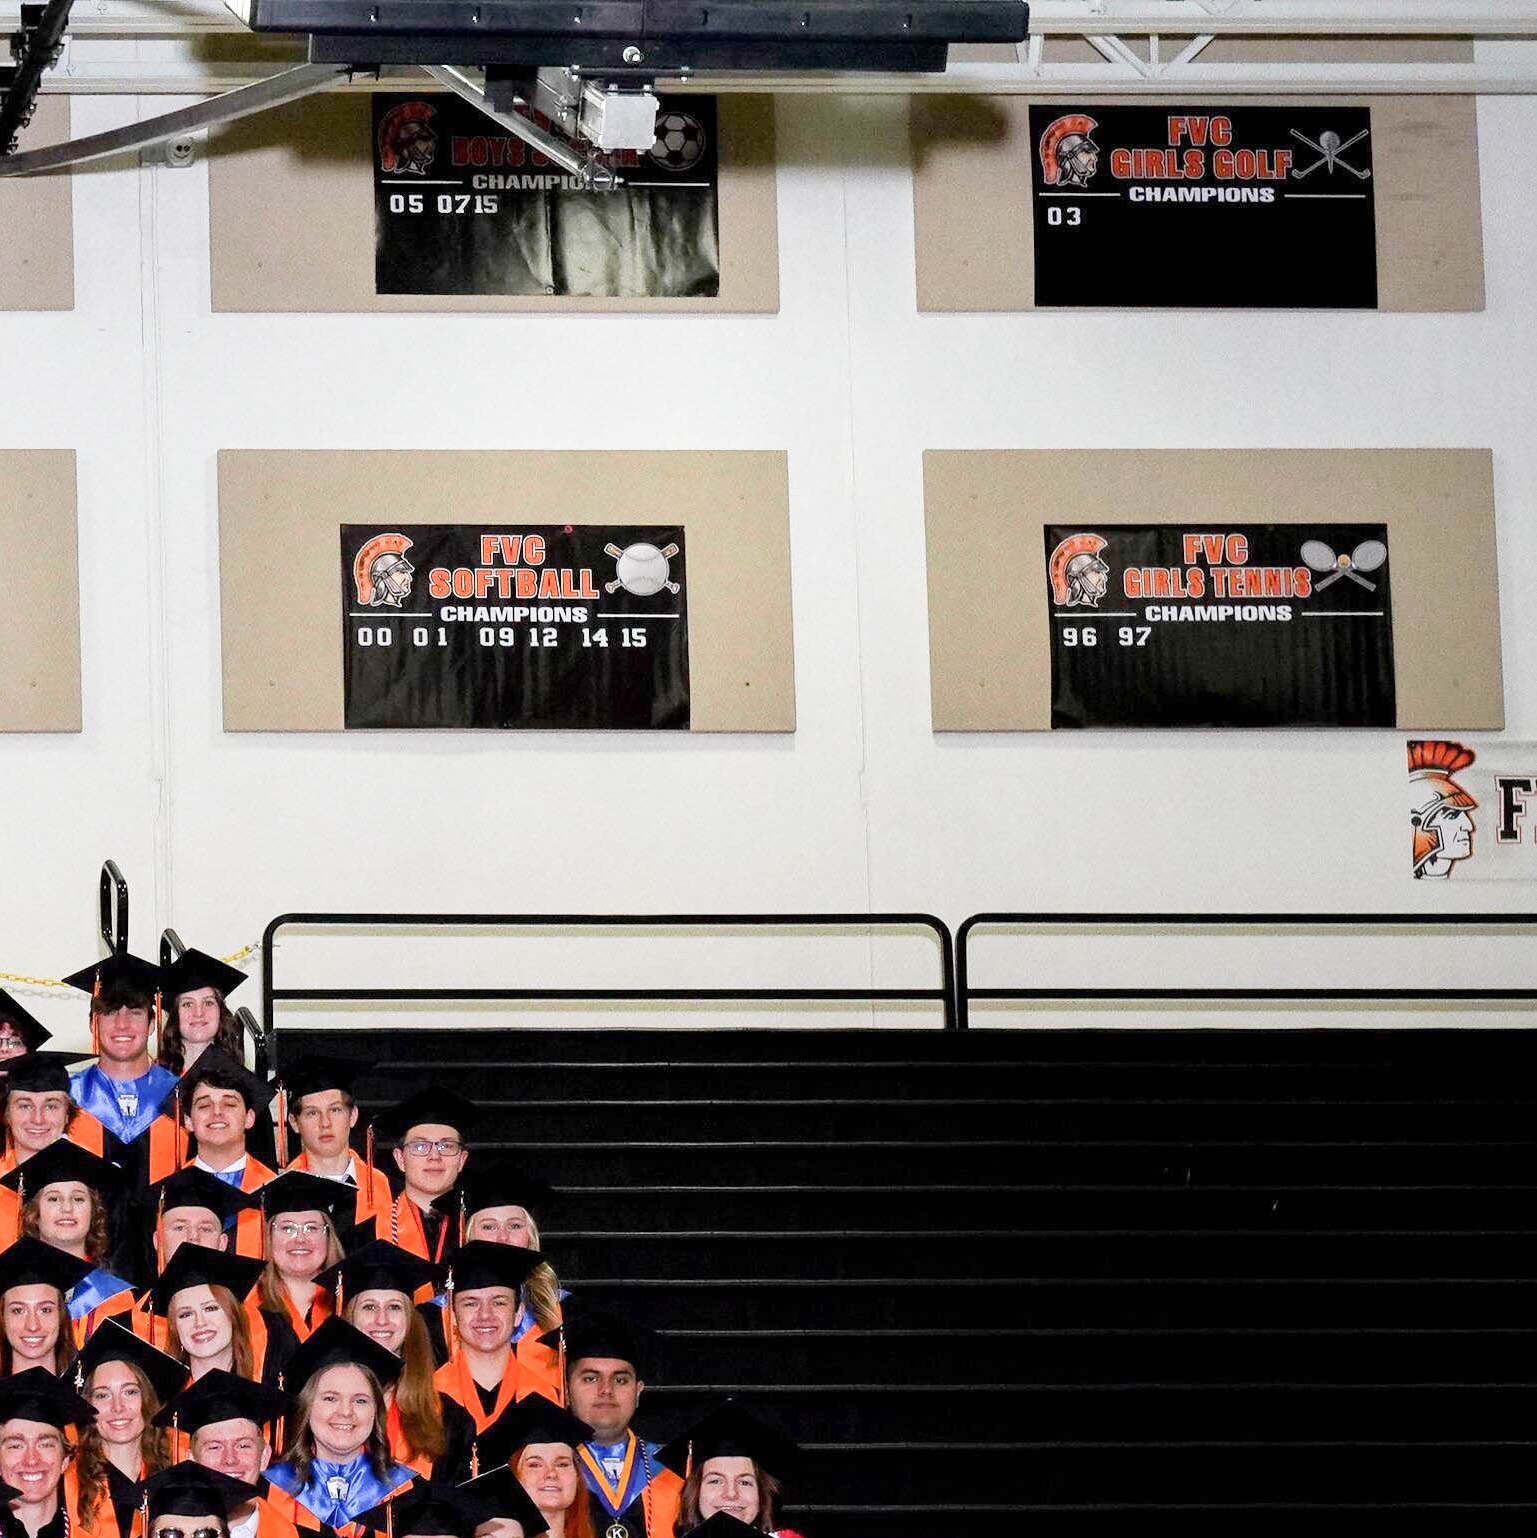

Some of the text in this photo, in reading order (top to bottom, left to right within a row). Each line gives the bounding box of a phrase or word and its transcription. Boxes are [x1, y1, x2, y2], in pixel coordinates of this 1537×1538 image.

[1168, 115, 1232, 146] FVC
[451, 136, 525, 166] BOYS
[1110, 149, 1293, 180] GIRLS GOLF
[389, 194, 423, 214] 05
[1128, 186, 1275, 203] CHAMPIONS
[1047, 207, 1081, 226] 03
[480, 534, 546, 566] FVC
[1183, 533, 1249, 564] FVC
[429, 568, 600, 600] SOFTBALL
[1123, 567, 1312, 598] GIRLS TENNIS
[440, 606, 588, 623] CHAMPIONS
[1145, 605, 1293, 622] CHAMPIONS
[358, 627, 647, 648] 00 01 09 12 14 15
[1063, 627, 1152, 647] 96 97
